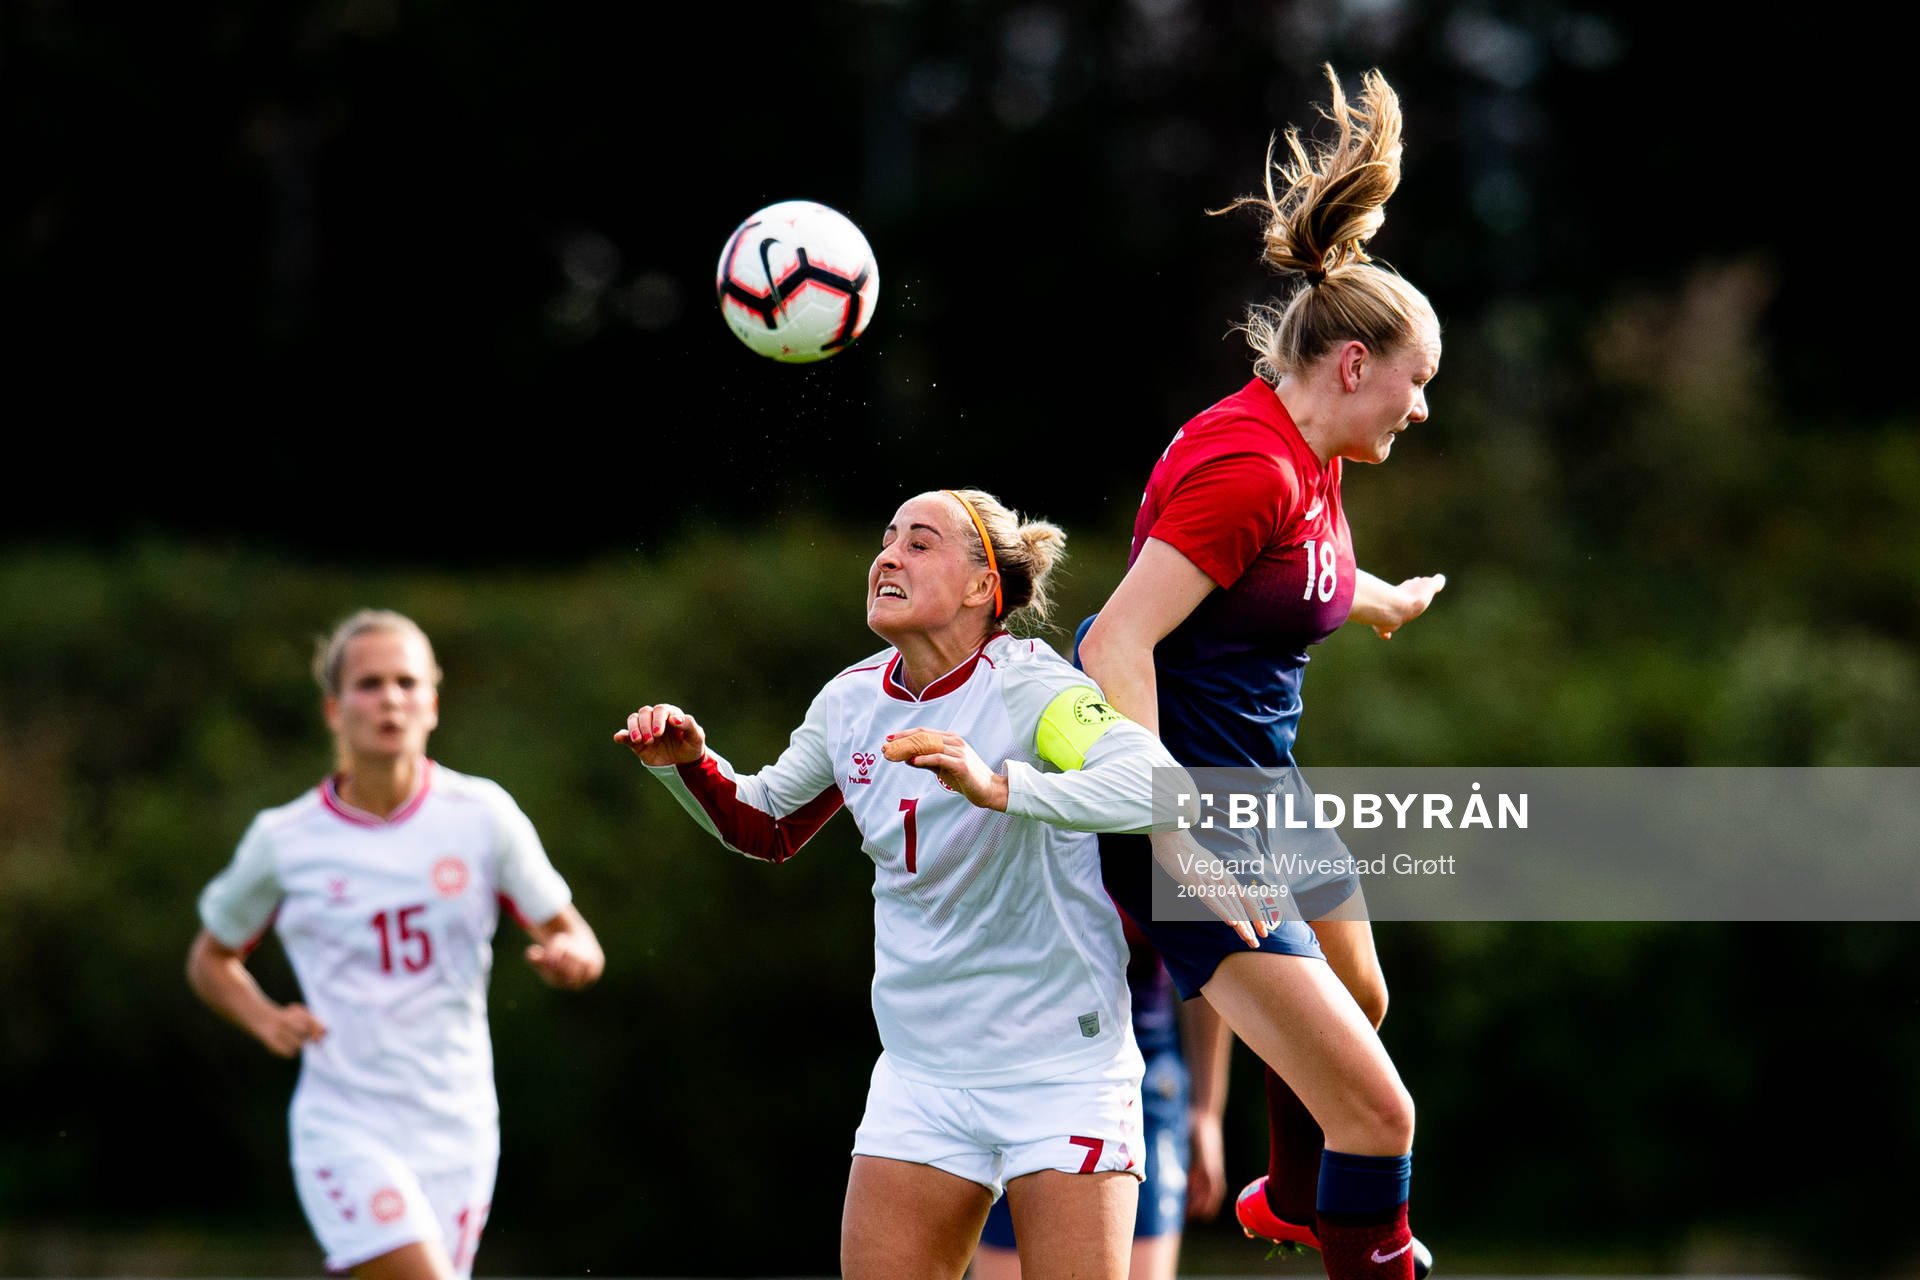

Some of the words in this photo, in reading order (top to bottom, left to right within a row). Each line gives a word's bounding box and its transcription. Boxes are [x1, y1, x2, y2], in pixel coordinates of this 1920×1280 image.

[1303, 540, 1338, 603] 18
[370, 904, 433, 975] 15
[1069, 1135, 1105, 1174] 7
